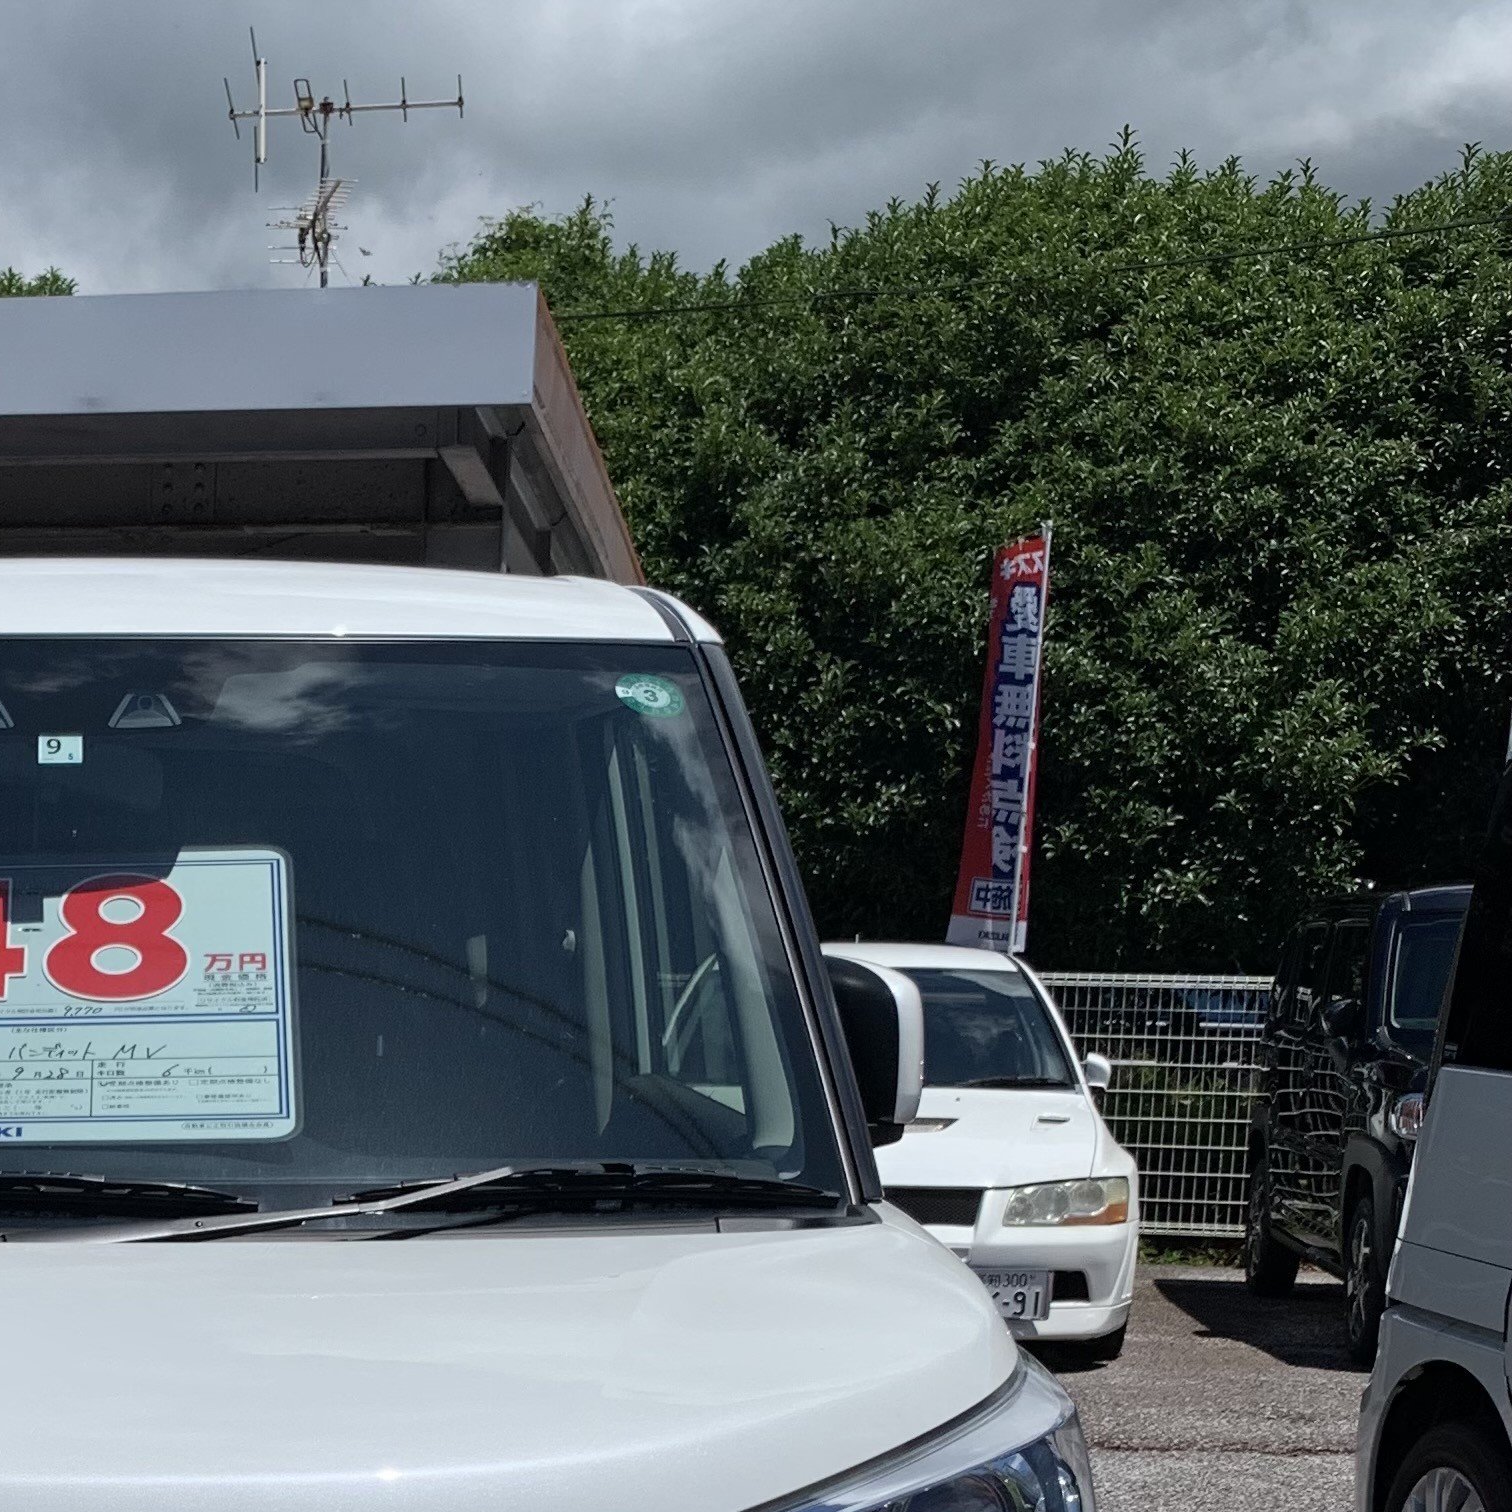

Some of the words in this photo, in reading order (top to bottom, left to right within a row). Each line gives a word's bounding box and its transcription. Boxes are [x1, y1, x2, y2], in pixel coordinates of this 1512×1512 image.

[643, 689, 659, 703] 3
[46, 738, 62, 755] 9
[203, 952, 267, 973] 万円
[1002, 1273, 1028, 1288] 300
[991, 1291, 1041, 1316] -91
